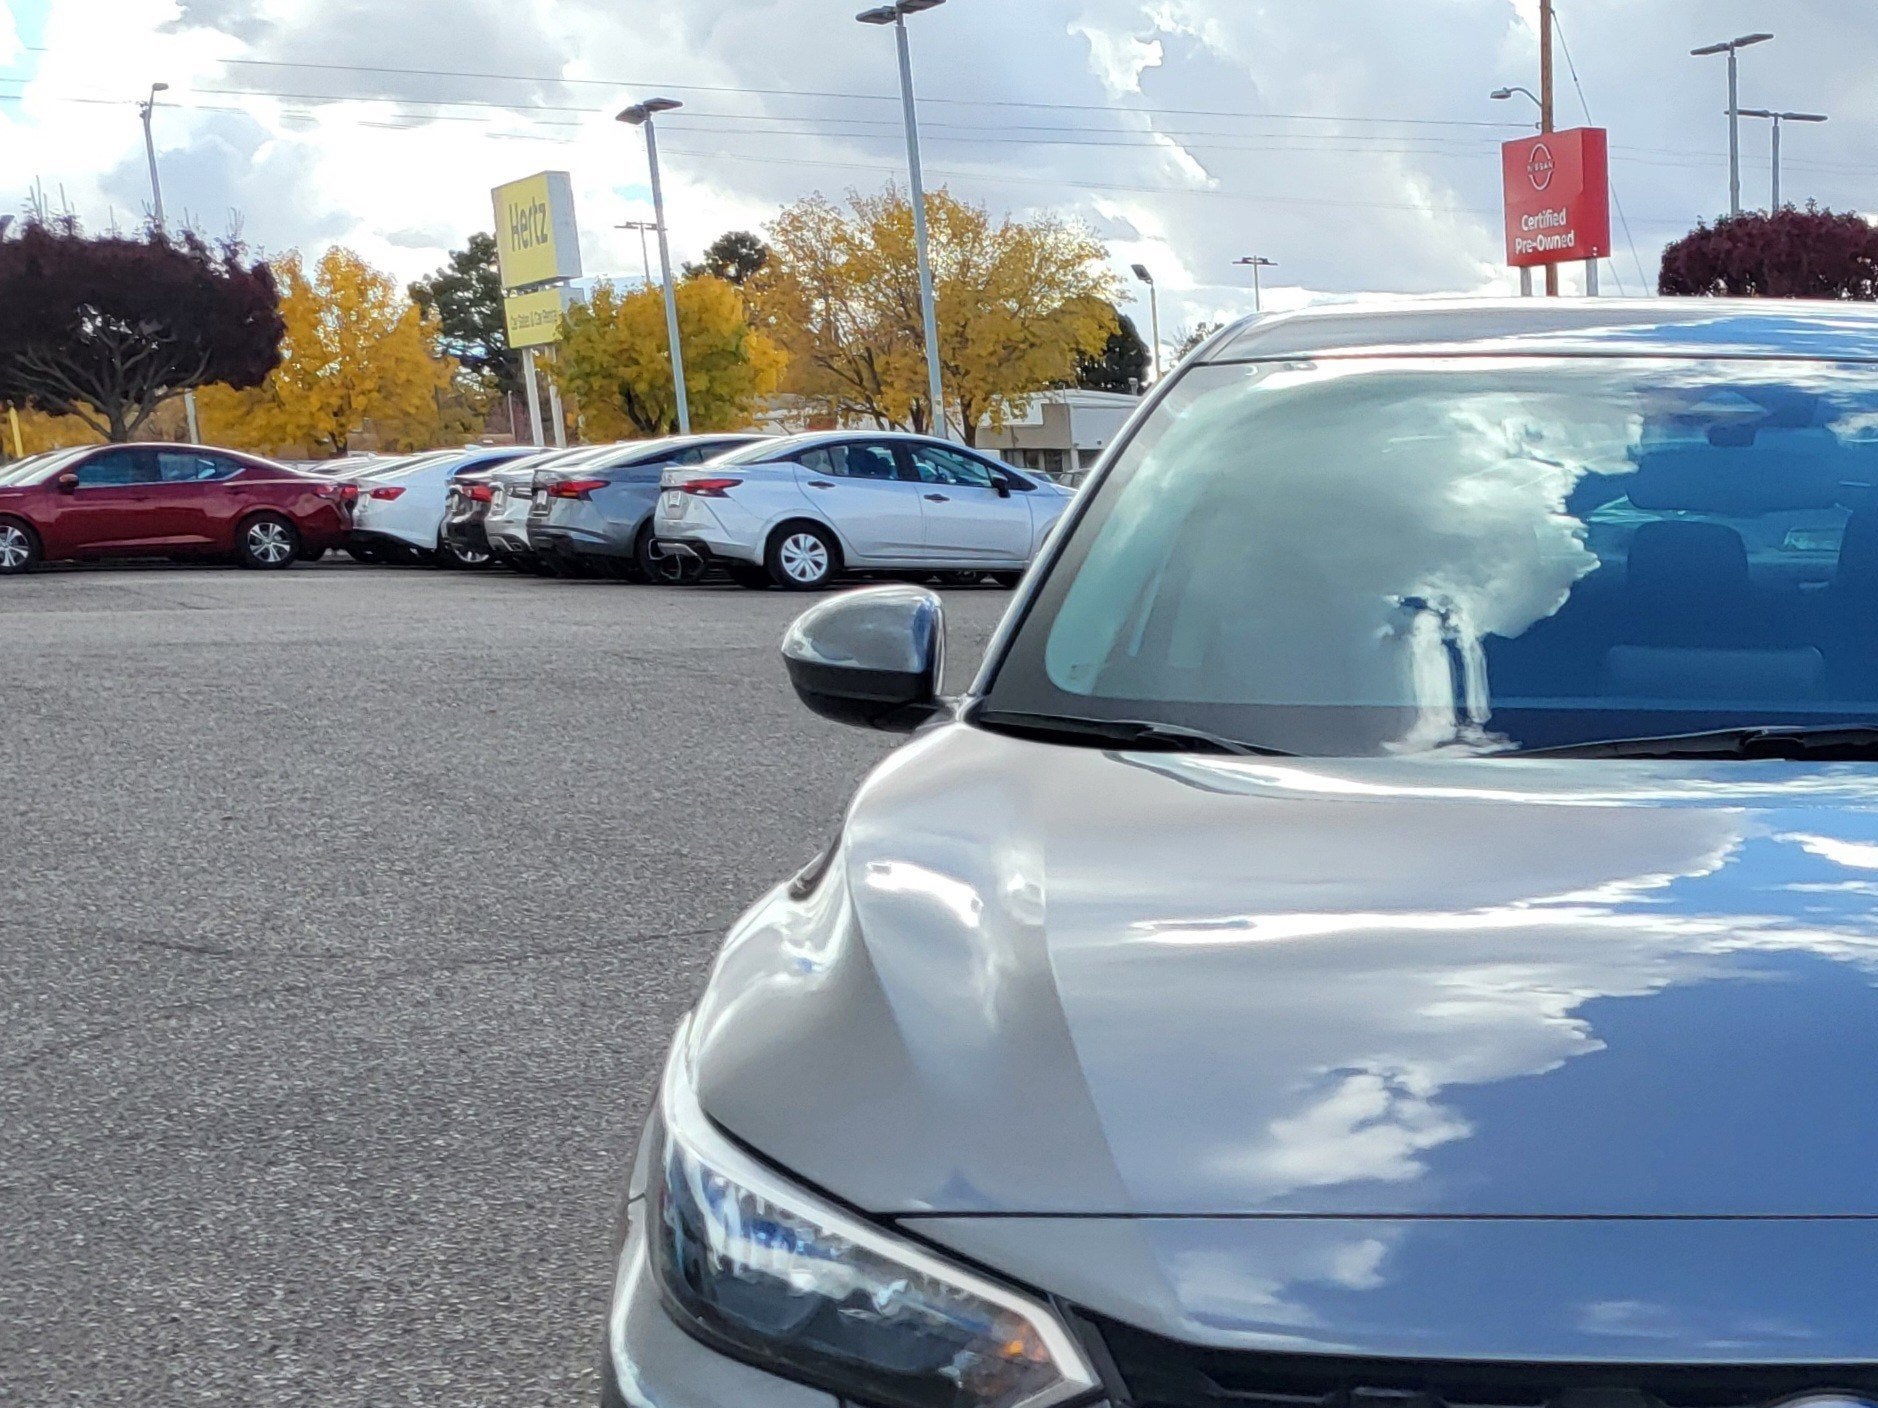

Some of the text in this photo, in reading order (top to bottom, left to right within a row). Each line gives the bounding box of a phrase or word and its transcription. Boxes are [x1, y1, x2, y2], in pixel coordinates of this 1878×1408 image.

[509, 196, 548, 251] Hertz
[1521, 207, 1567, 231] Certified
[1515, 230, 1575, 254] Pre-Owned
